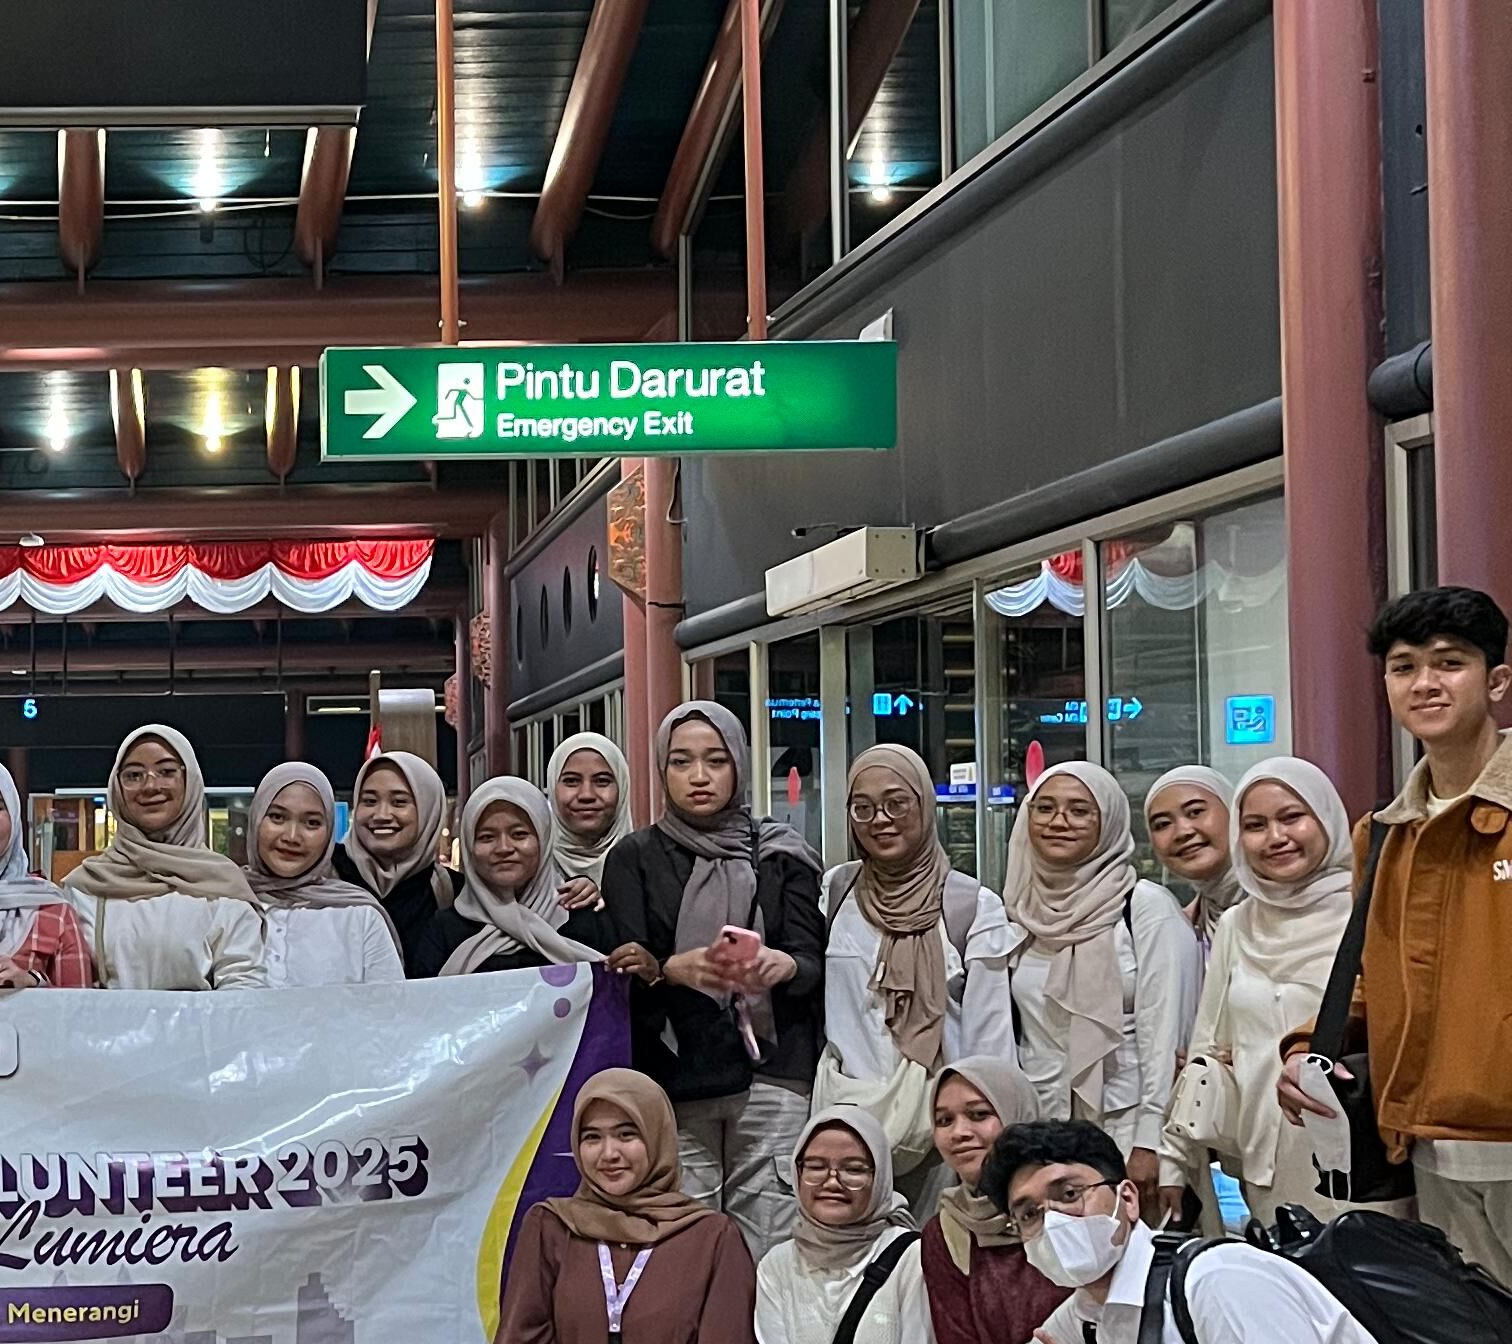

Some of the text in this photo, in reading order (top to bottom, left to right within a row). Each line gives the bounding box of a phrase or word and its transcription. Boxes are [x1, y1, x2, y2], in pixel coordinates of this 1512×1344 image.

[496, 359, 766, 401] Pintu Darurat
[496, 410, 694, 443] Emergency Exit
[276, 1134, 430, 1208] 2025
[7, 1299, 140, 1325] Menerangi
